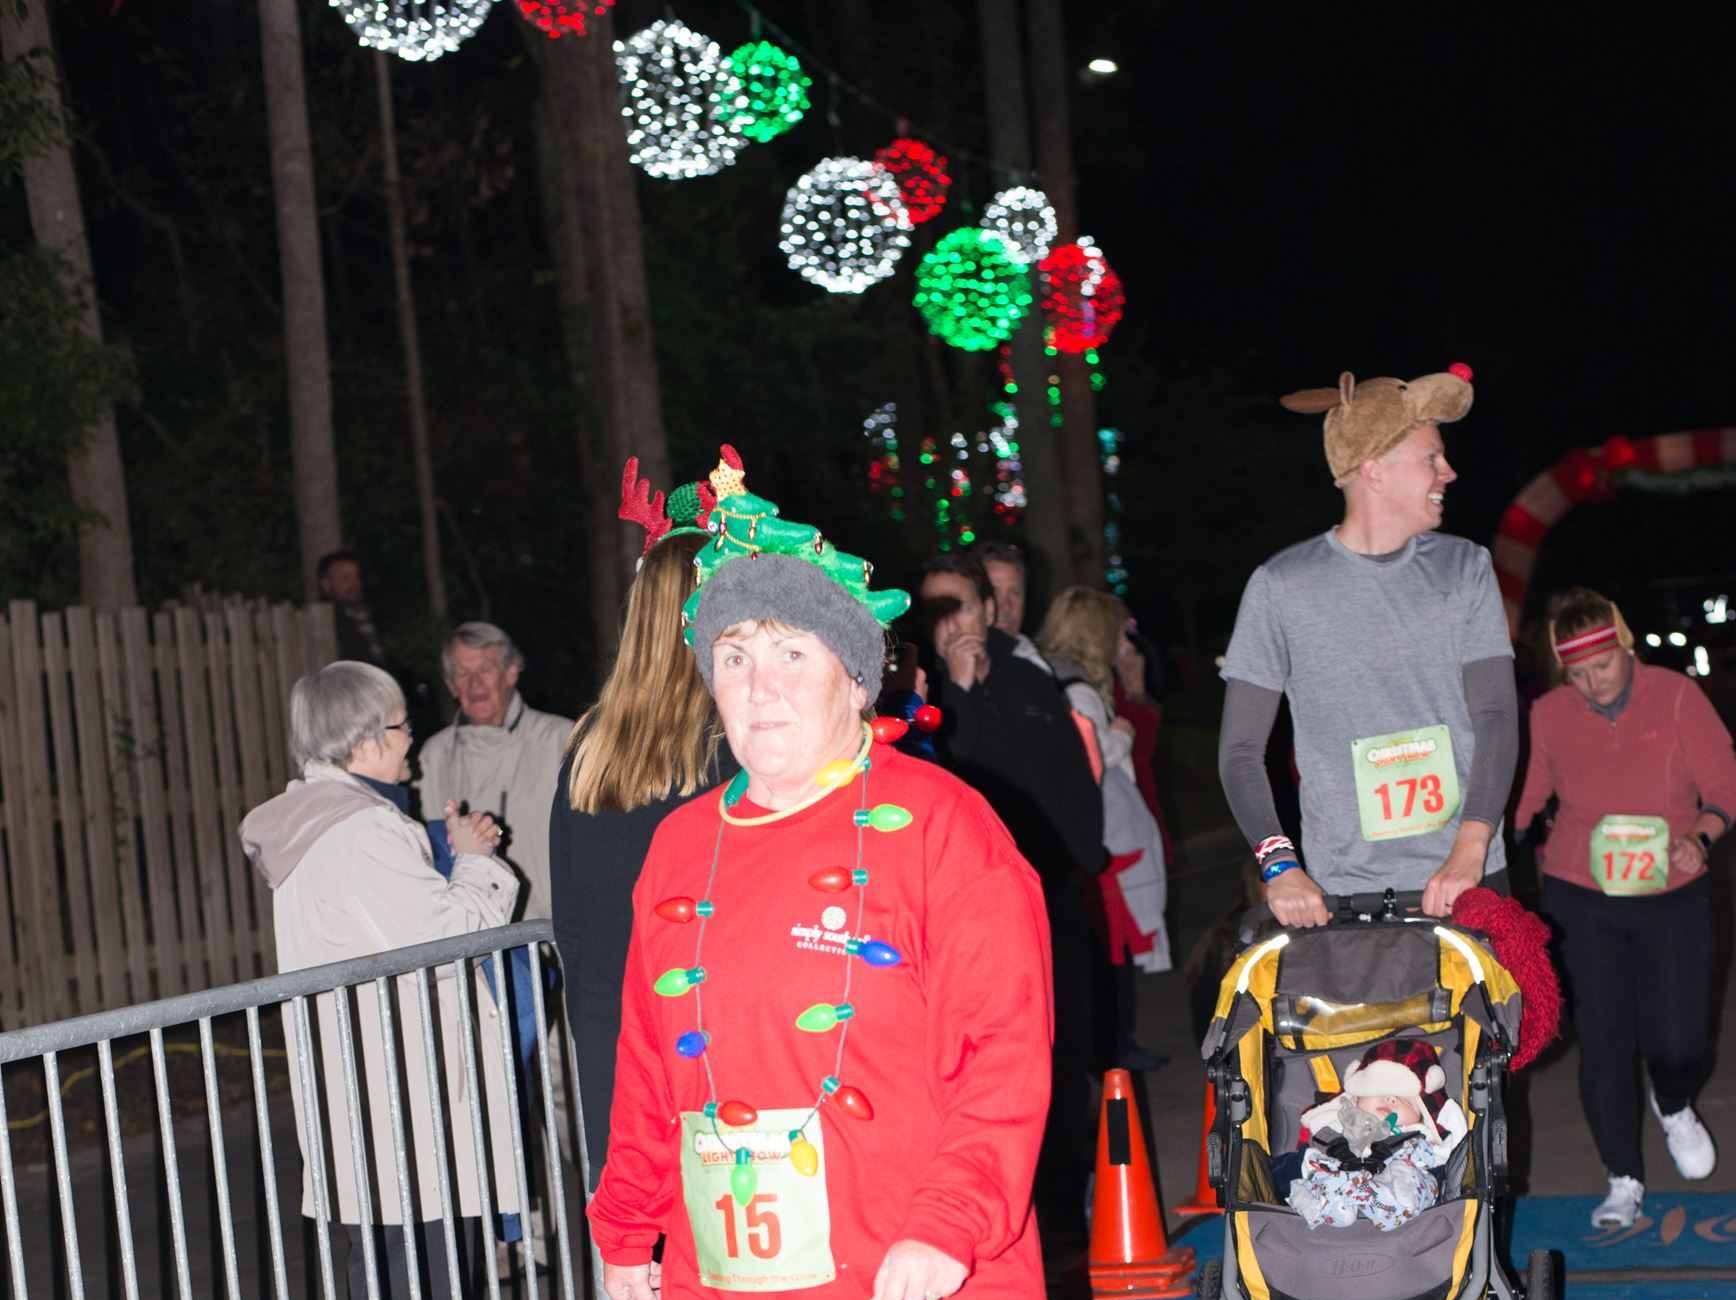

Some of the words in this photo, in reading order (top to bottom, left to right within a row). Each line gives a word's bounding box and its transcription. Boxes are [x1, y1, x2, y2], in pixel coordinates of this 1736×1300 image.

[1374, 774, 1445, 821] 173
[1603, 850, 1656, 881] 172
[715, 1193, 782, 1260] 15
